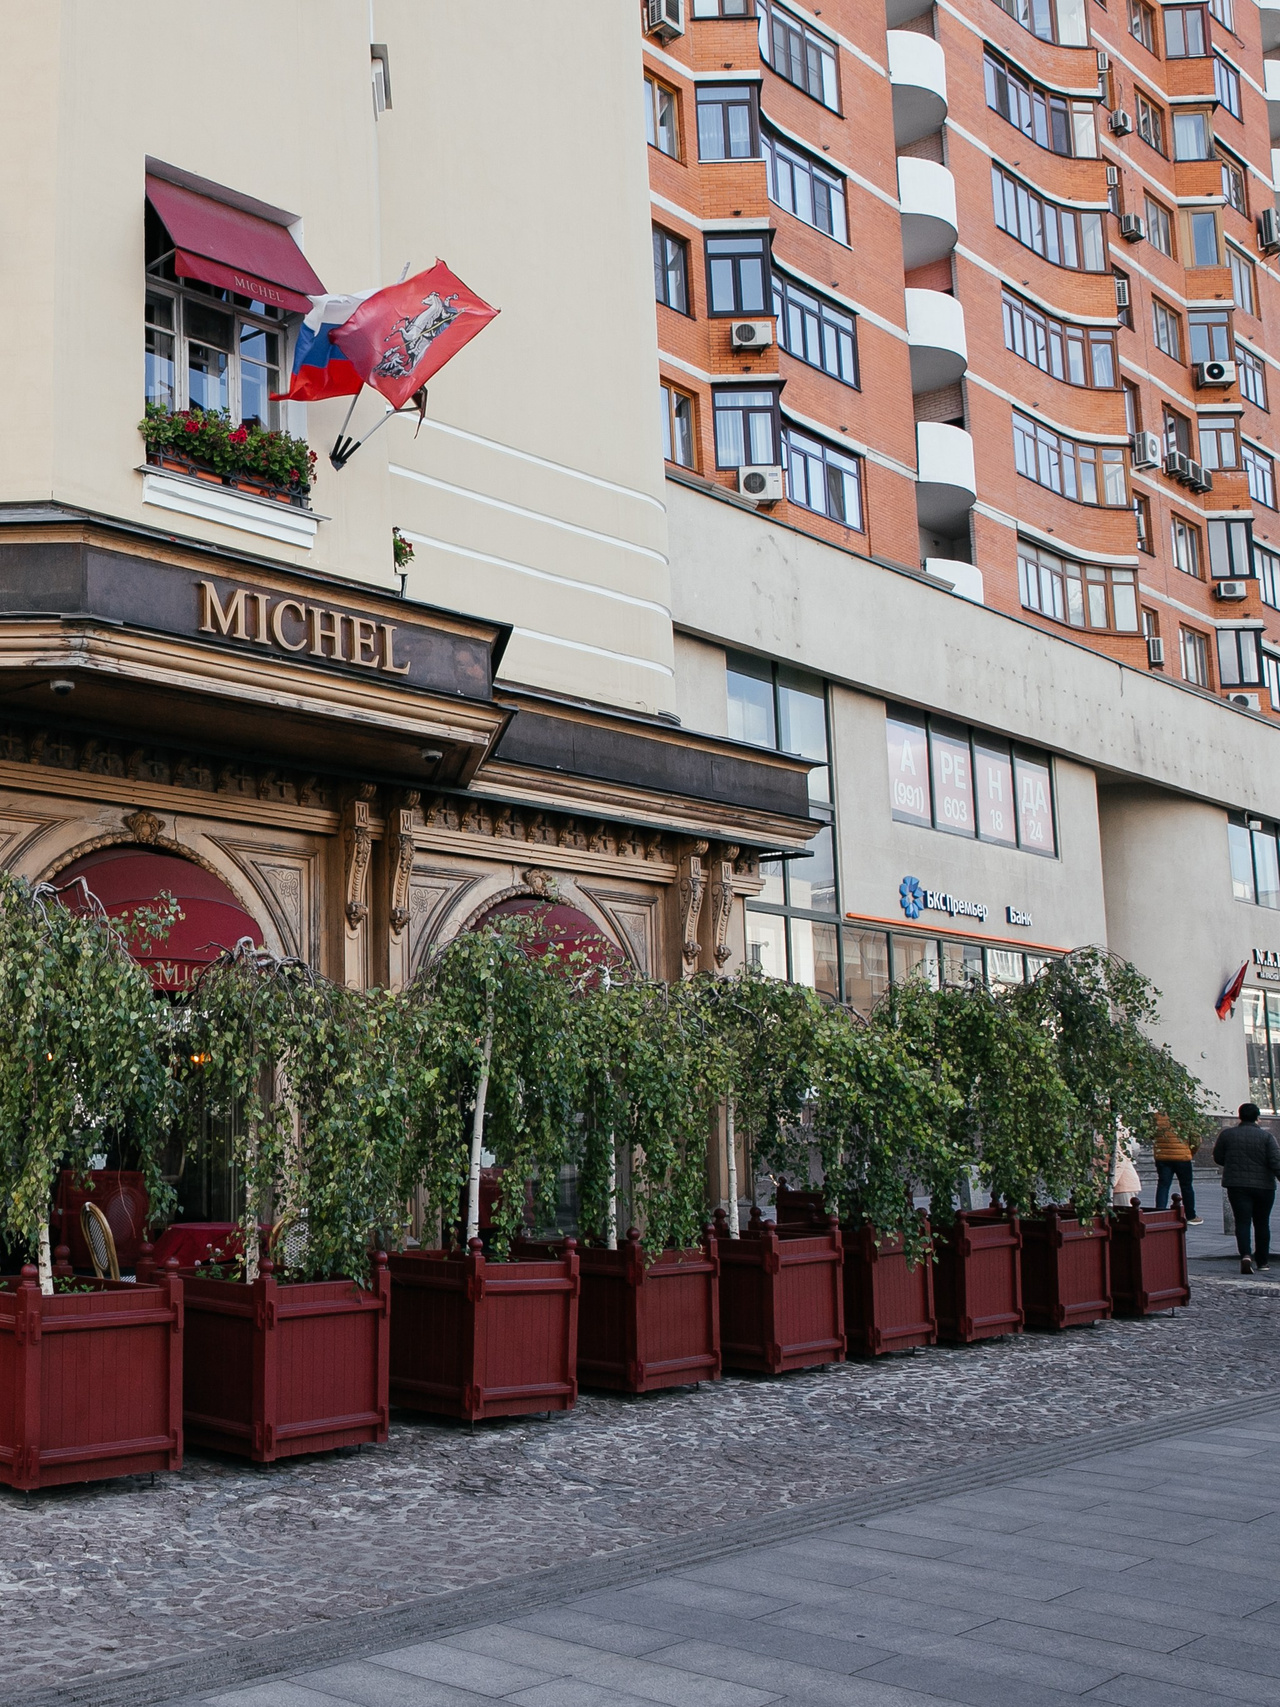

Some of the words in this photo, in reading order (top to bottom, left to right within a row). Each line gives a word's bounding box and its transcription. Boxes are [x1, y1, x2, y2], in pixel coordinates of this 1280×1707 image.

[234, 275, 284, 303] MICHEL
[198, 580, 411, 676] MICHEL
[893, 778, 924, 813] (991)
[943, 796, 968, 823] 603
[990, 808, 1004, 832] 18
[1028, 819, 1043, 842] 24
[926, 890, 947, 911] БКС
[947, 894, 989, 923] Премьер
[1009, 905, 1033, 926] Банк
